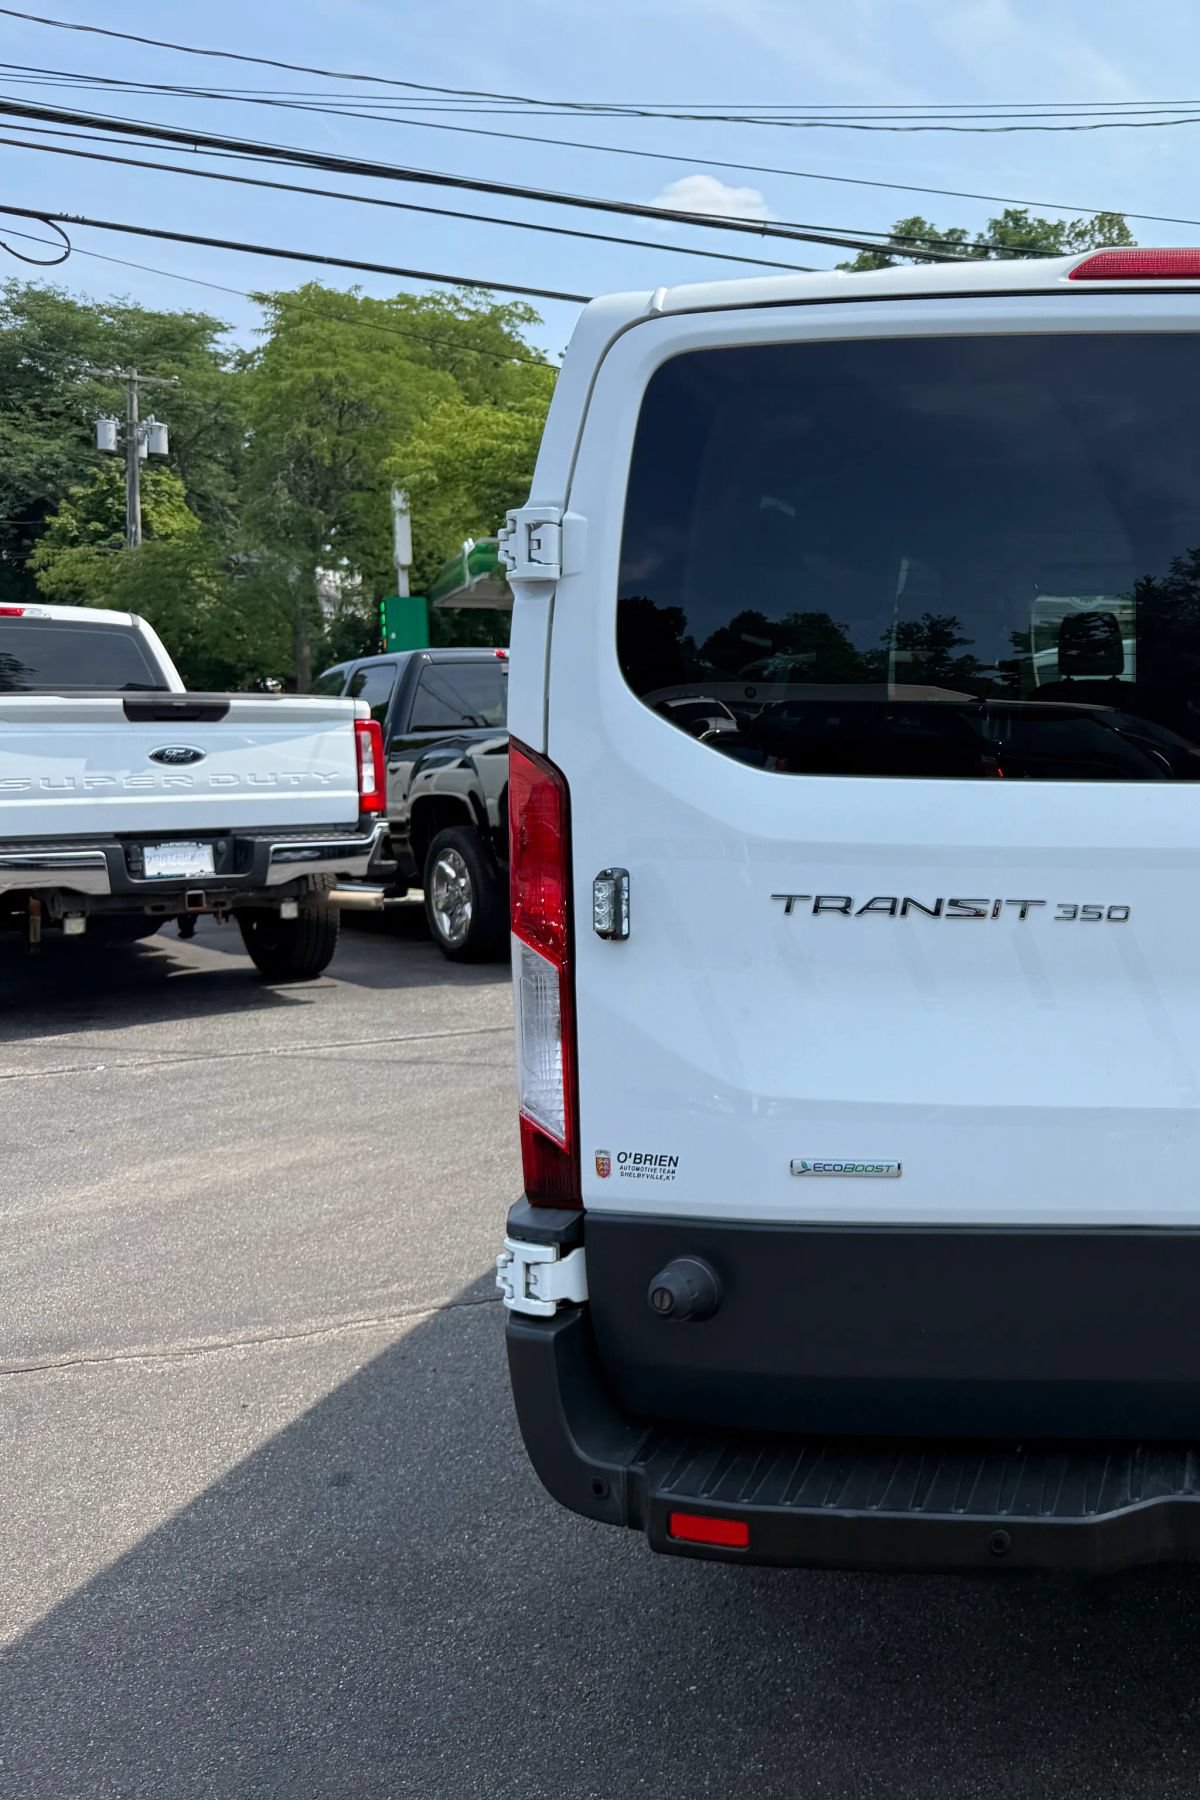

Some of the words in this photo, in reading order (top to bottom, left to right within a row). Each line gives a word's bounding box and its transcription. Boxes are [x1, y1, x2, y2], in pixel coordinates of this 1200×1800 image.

[162, 749, 194, 762] Ford
[0, 774, 194, 791] SUPER
[208, 771, 340, 787] DUTY
[770, 894, 1047, 920] TRANSIT
[1054, 903, 1132, 922] 350
[616, 1151, 679, 1168] O'BRIEN
[619, 1165, 657, 1173] AUTOMOTIVE
[813, 1163, 895, 1173] ECOBOOST
